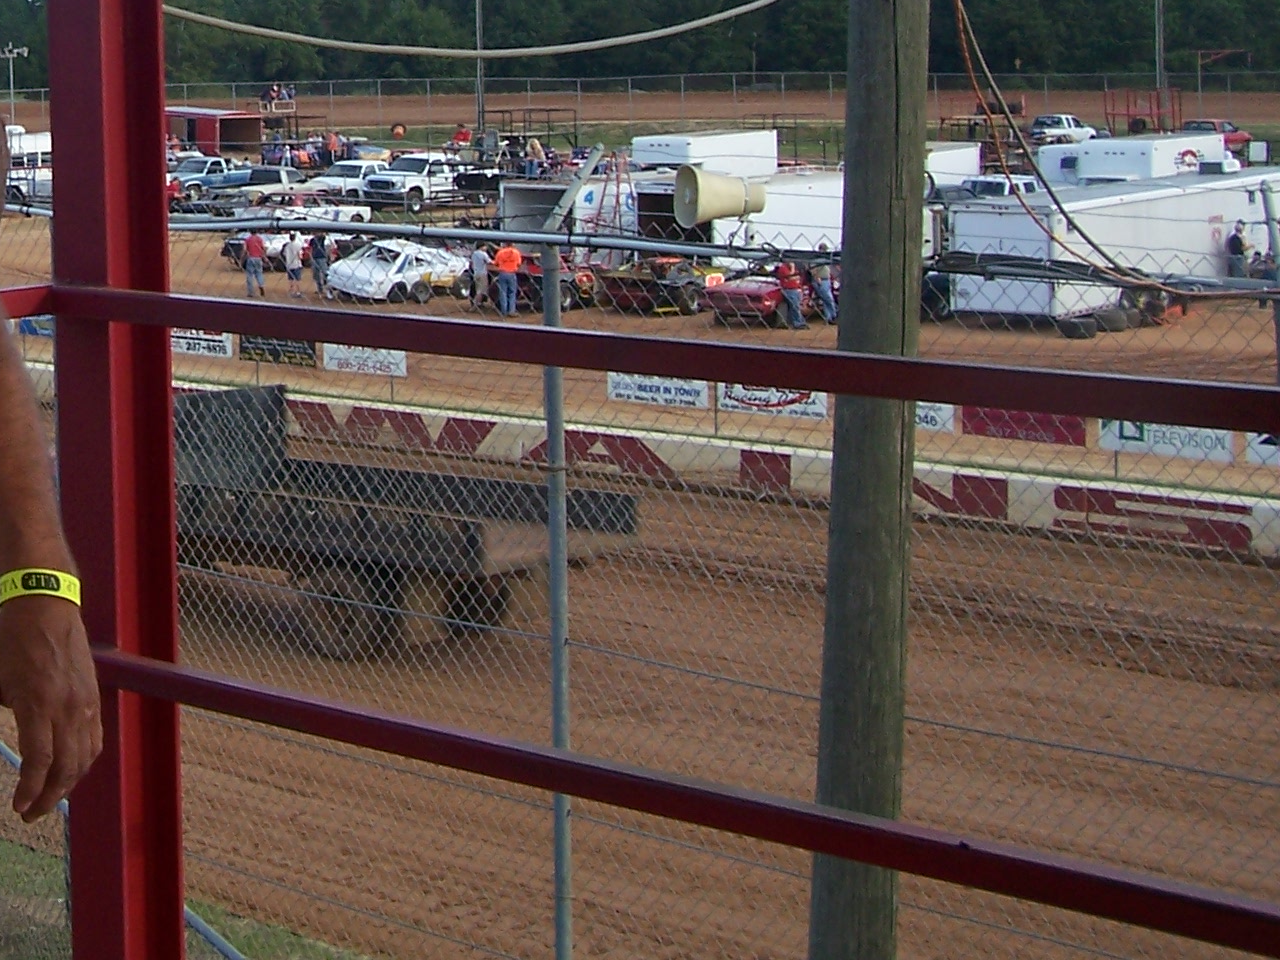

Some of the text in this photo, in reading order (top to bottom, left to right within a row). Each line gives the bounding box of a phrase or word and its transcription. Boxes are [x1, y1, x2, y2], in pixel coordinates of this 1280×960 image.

[637, 383, 661, 394] BEER
[663, 386, 672, 395] IN
[674, 387, 701, 397] TOWN
[1147, 428, 1227, 451] TELEVISION
